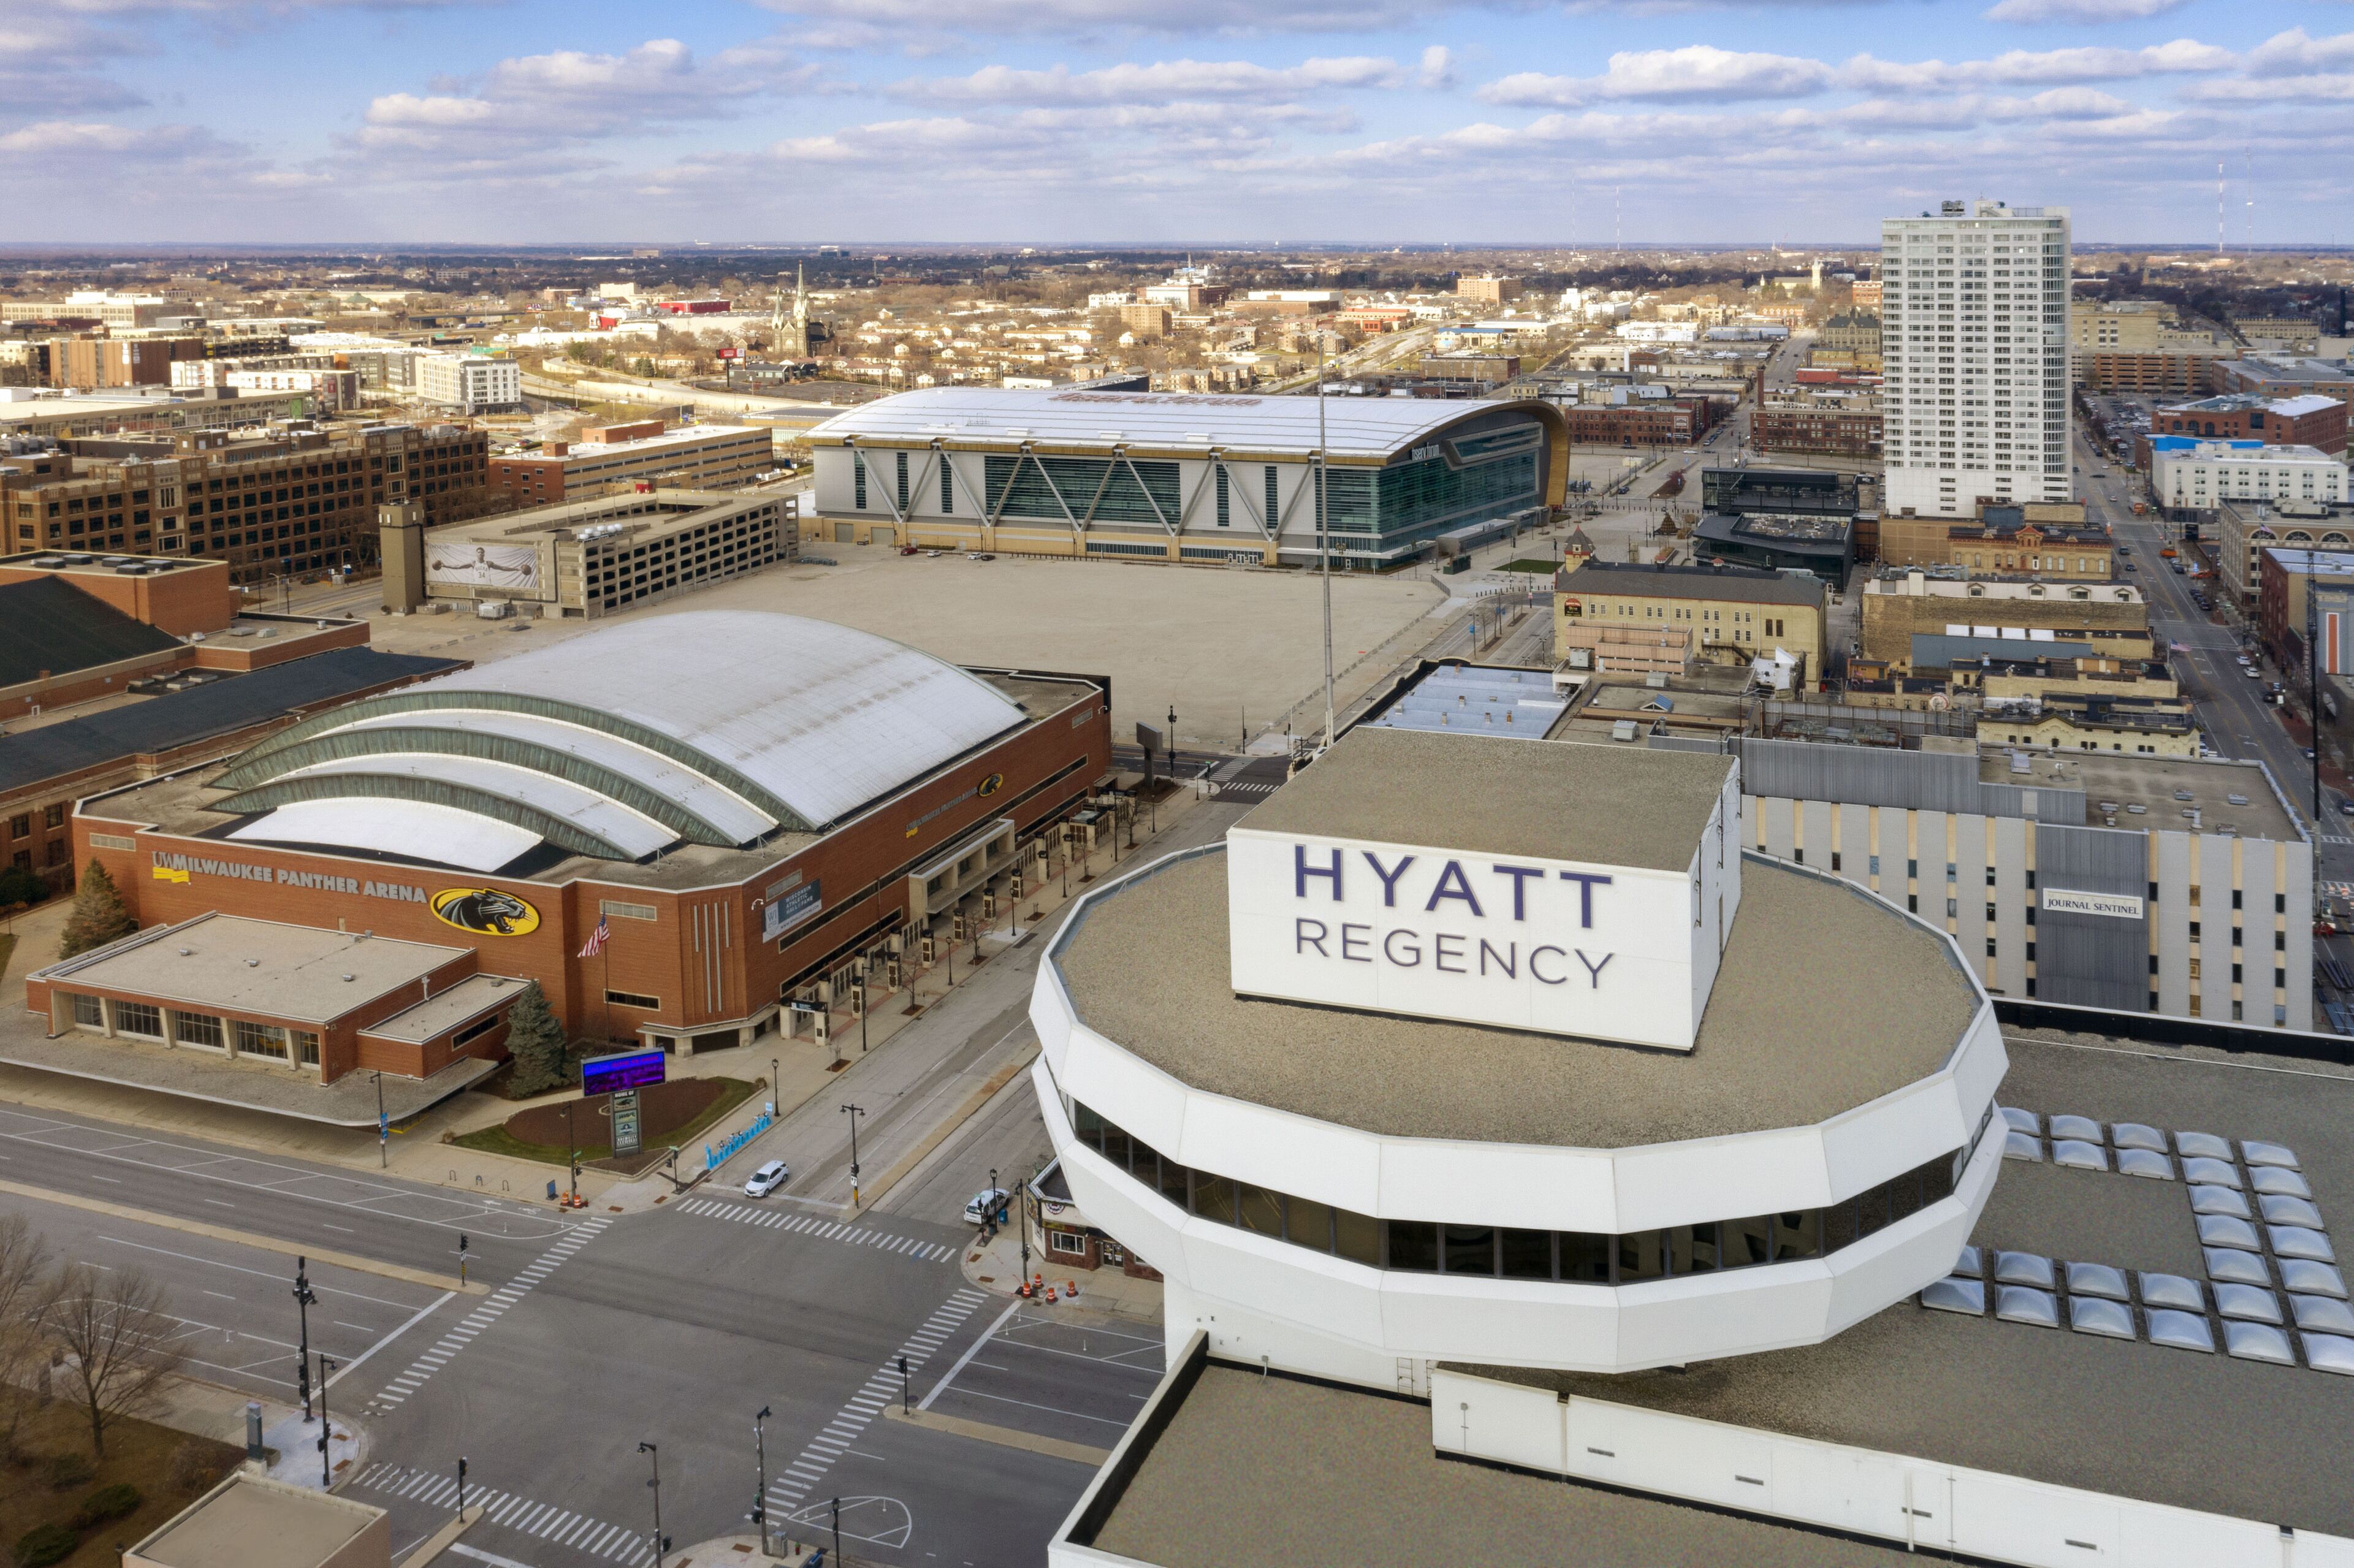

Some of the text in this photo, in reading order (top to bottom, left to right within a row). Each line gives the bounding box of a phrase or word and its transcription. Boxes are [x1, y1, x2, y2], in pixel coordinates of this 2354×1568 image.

[277, 869, 359, 894] PANTHER
[363, 880, 428, 904] ARENA
[785, 885, 812, 903] WISCONSIN
[1294, 843, 1614, 929] HYATT
[786, 893, 807, 908] ATHLETIC
[2047, 899, 2139, 915] JOURNAL SENTINEL
[1295, 918, 1615, 989] REGENCY
